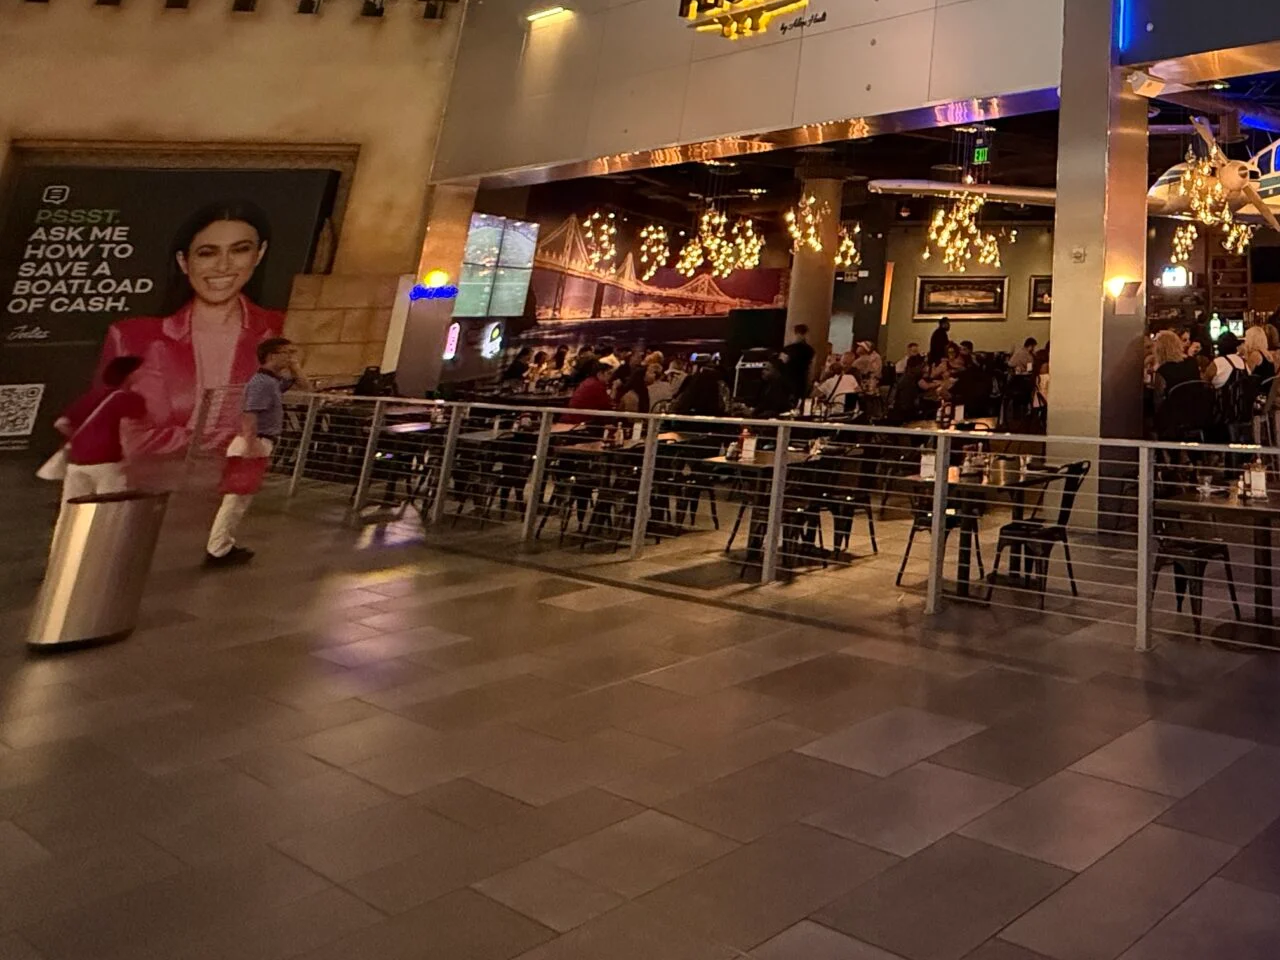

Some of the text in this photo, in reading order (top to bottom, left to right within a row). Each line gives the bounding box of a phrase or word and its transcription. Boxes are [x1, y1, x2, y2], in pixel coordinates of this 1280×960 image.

[35, 208, 121, 224] PSSST.
[28, 226, 130, 242] ASK ME
[24, 243, 134, 259] HOW TO
[18, 261, 111, 277] SAVE A
[12, 278, 153, 295] BOATLOAD
[7, 296, 130, 313] OF CASH.
